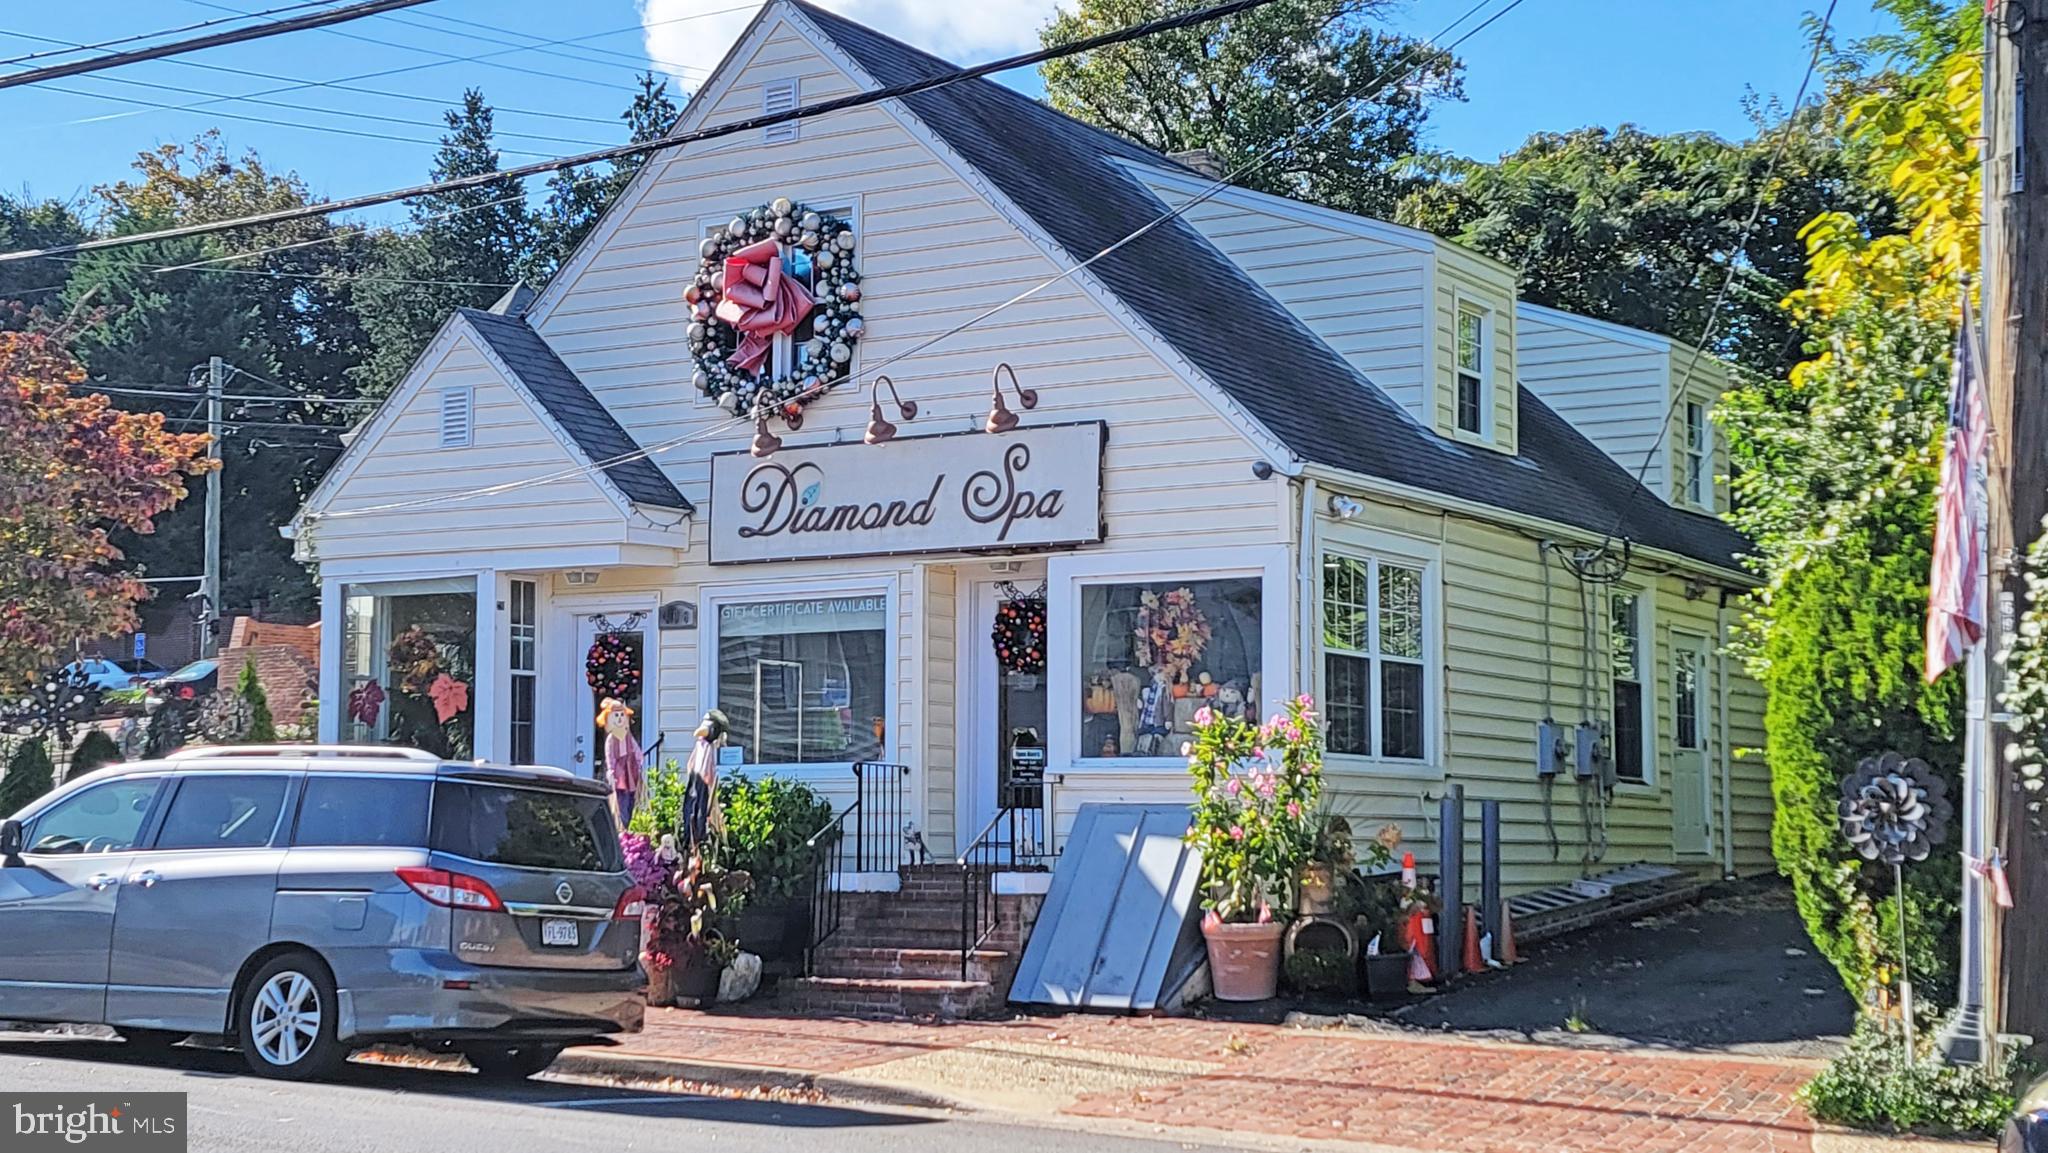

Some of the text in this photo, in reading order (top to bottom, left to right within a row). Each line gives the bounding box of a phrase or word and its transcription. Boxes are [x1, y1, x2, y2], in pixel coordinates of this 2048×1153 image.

[738, 442, 1064, 541] Diamond Spa
[721, 598, 885, 619] GIFT CERTIFICATE AVAILABLE
